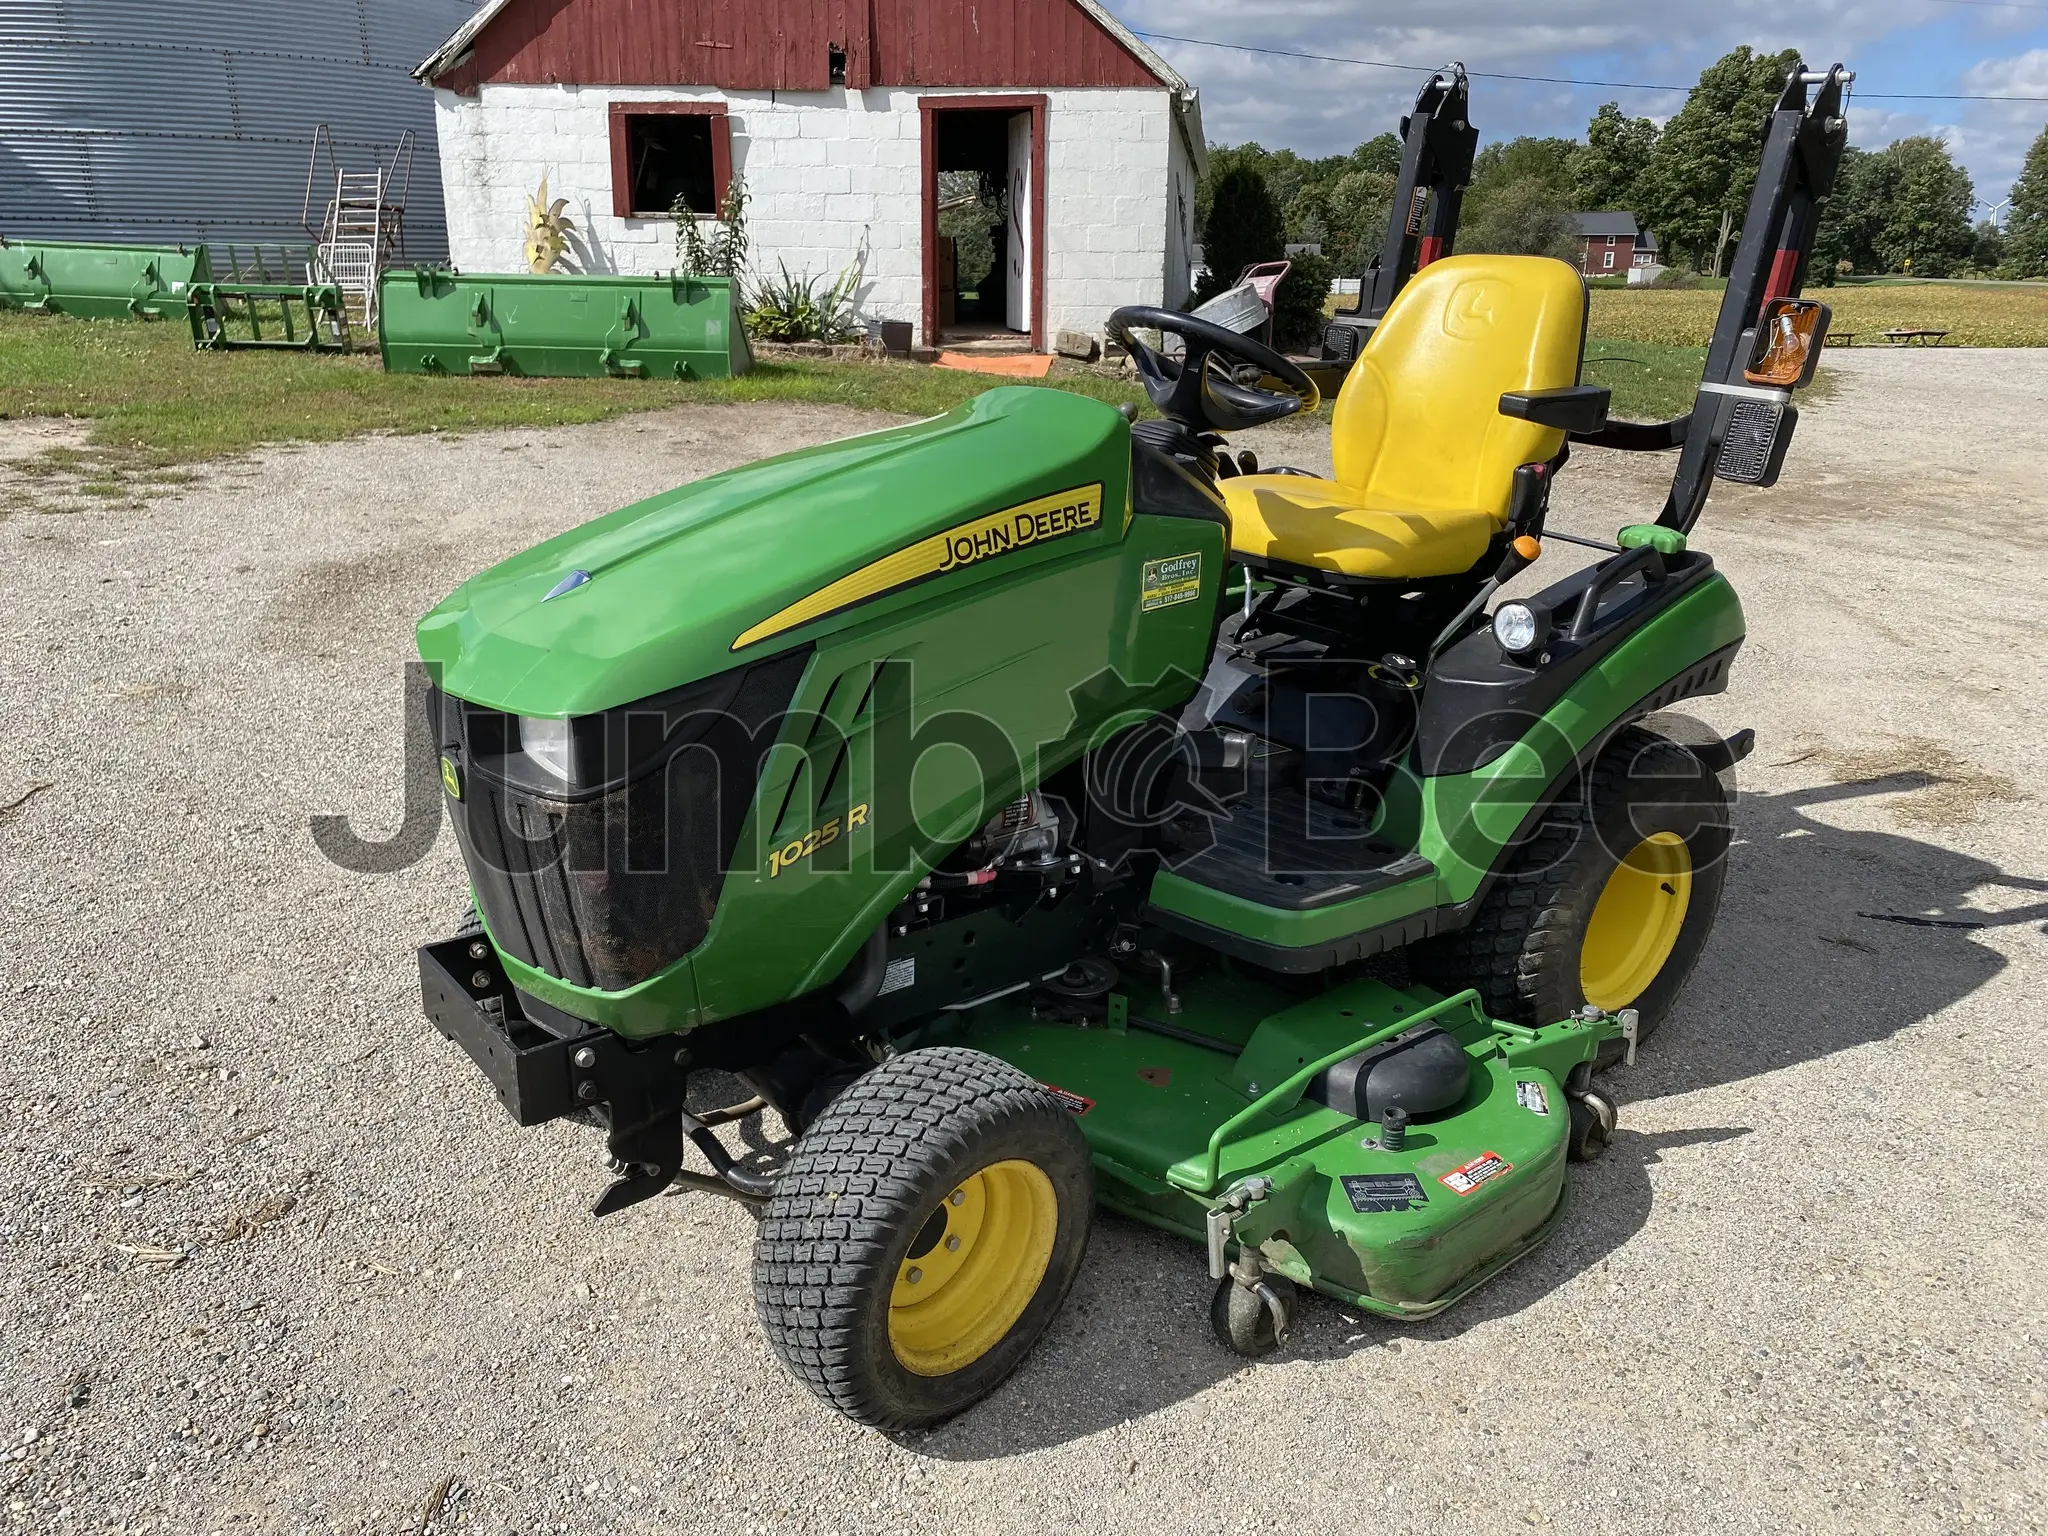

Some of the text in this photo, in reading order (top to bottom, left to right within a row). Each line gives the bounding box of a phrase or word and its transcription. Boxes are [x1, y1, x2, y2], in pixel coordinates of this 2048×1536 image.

[938, 501, 1093, 571] JOHN DEERE
[1160, 559, 1197, 574] Godfrey
[1182, 569, 1196, 577] Inc.
[768, 803, 869, 879] 1025 R
